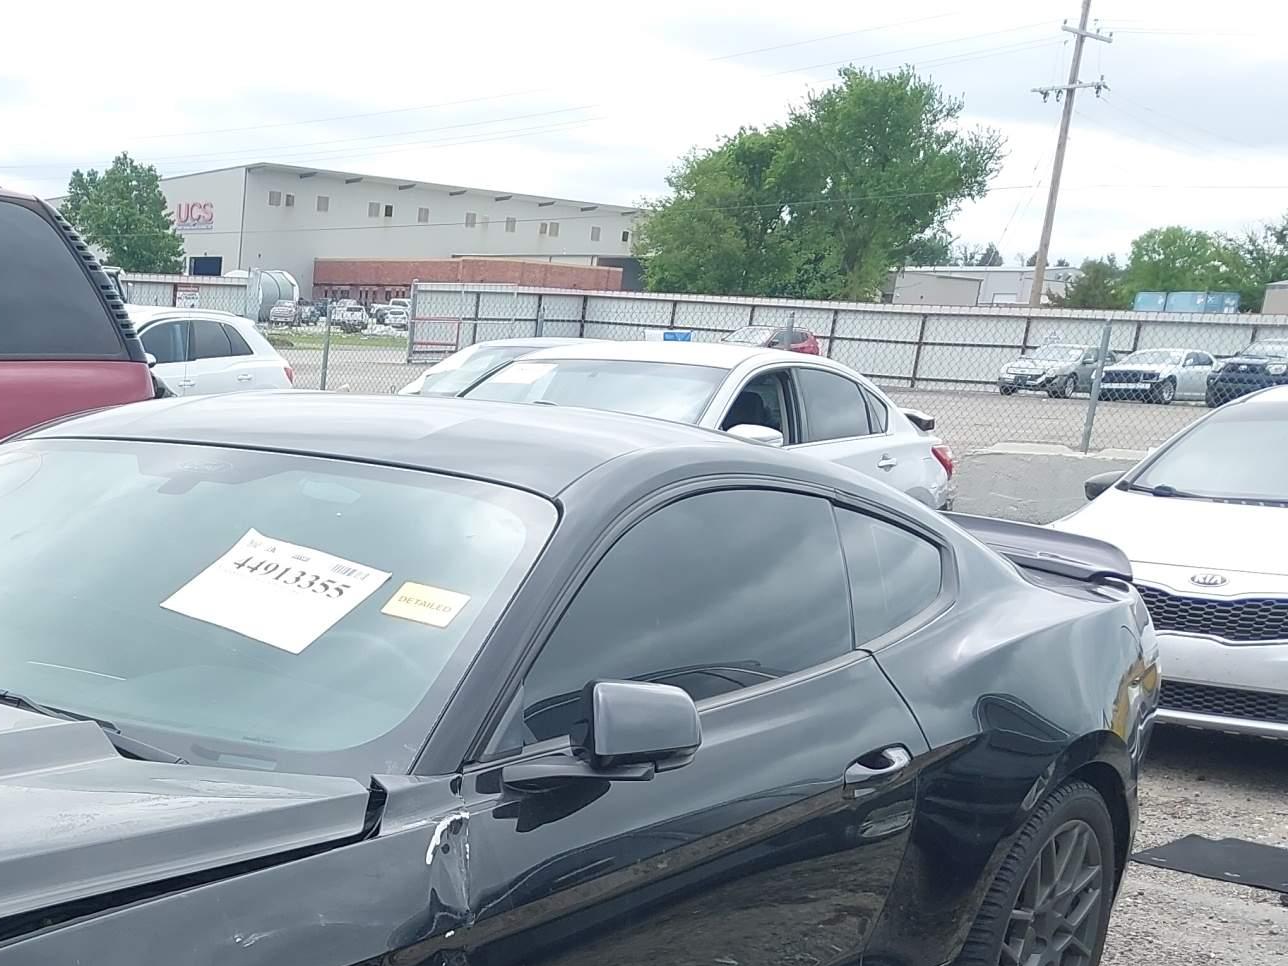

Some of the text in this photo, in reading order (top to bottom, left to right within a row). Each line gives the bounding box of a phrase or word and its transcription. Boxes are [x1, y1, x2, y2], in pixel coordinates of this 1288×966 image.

[177, 202, 214, 224] UCS
[233, 556, 352, 599] 44913355
[397, 595, 453, 613] DETAILED
